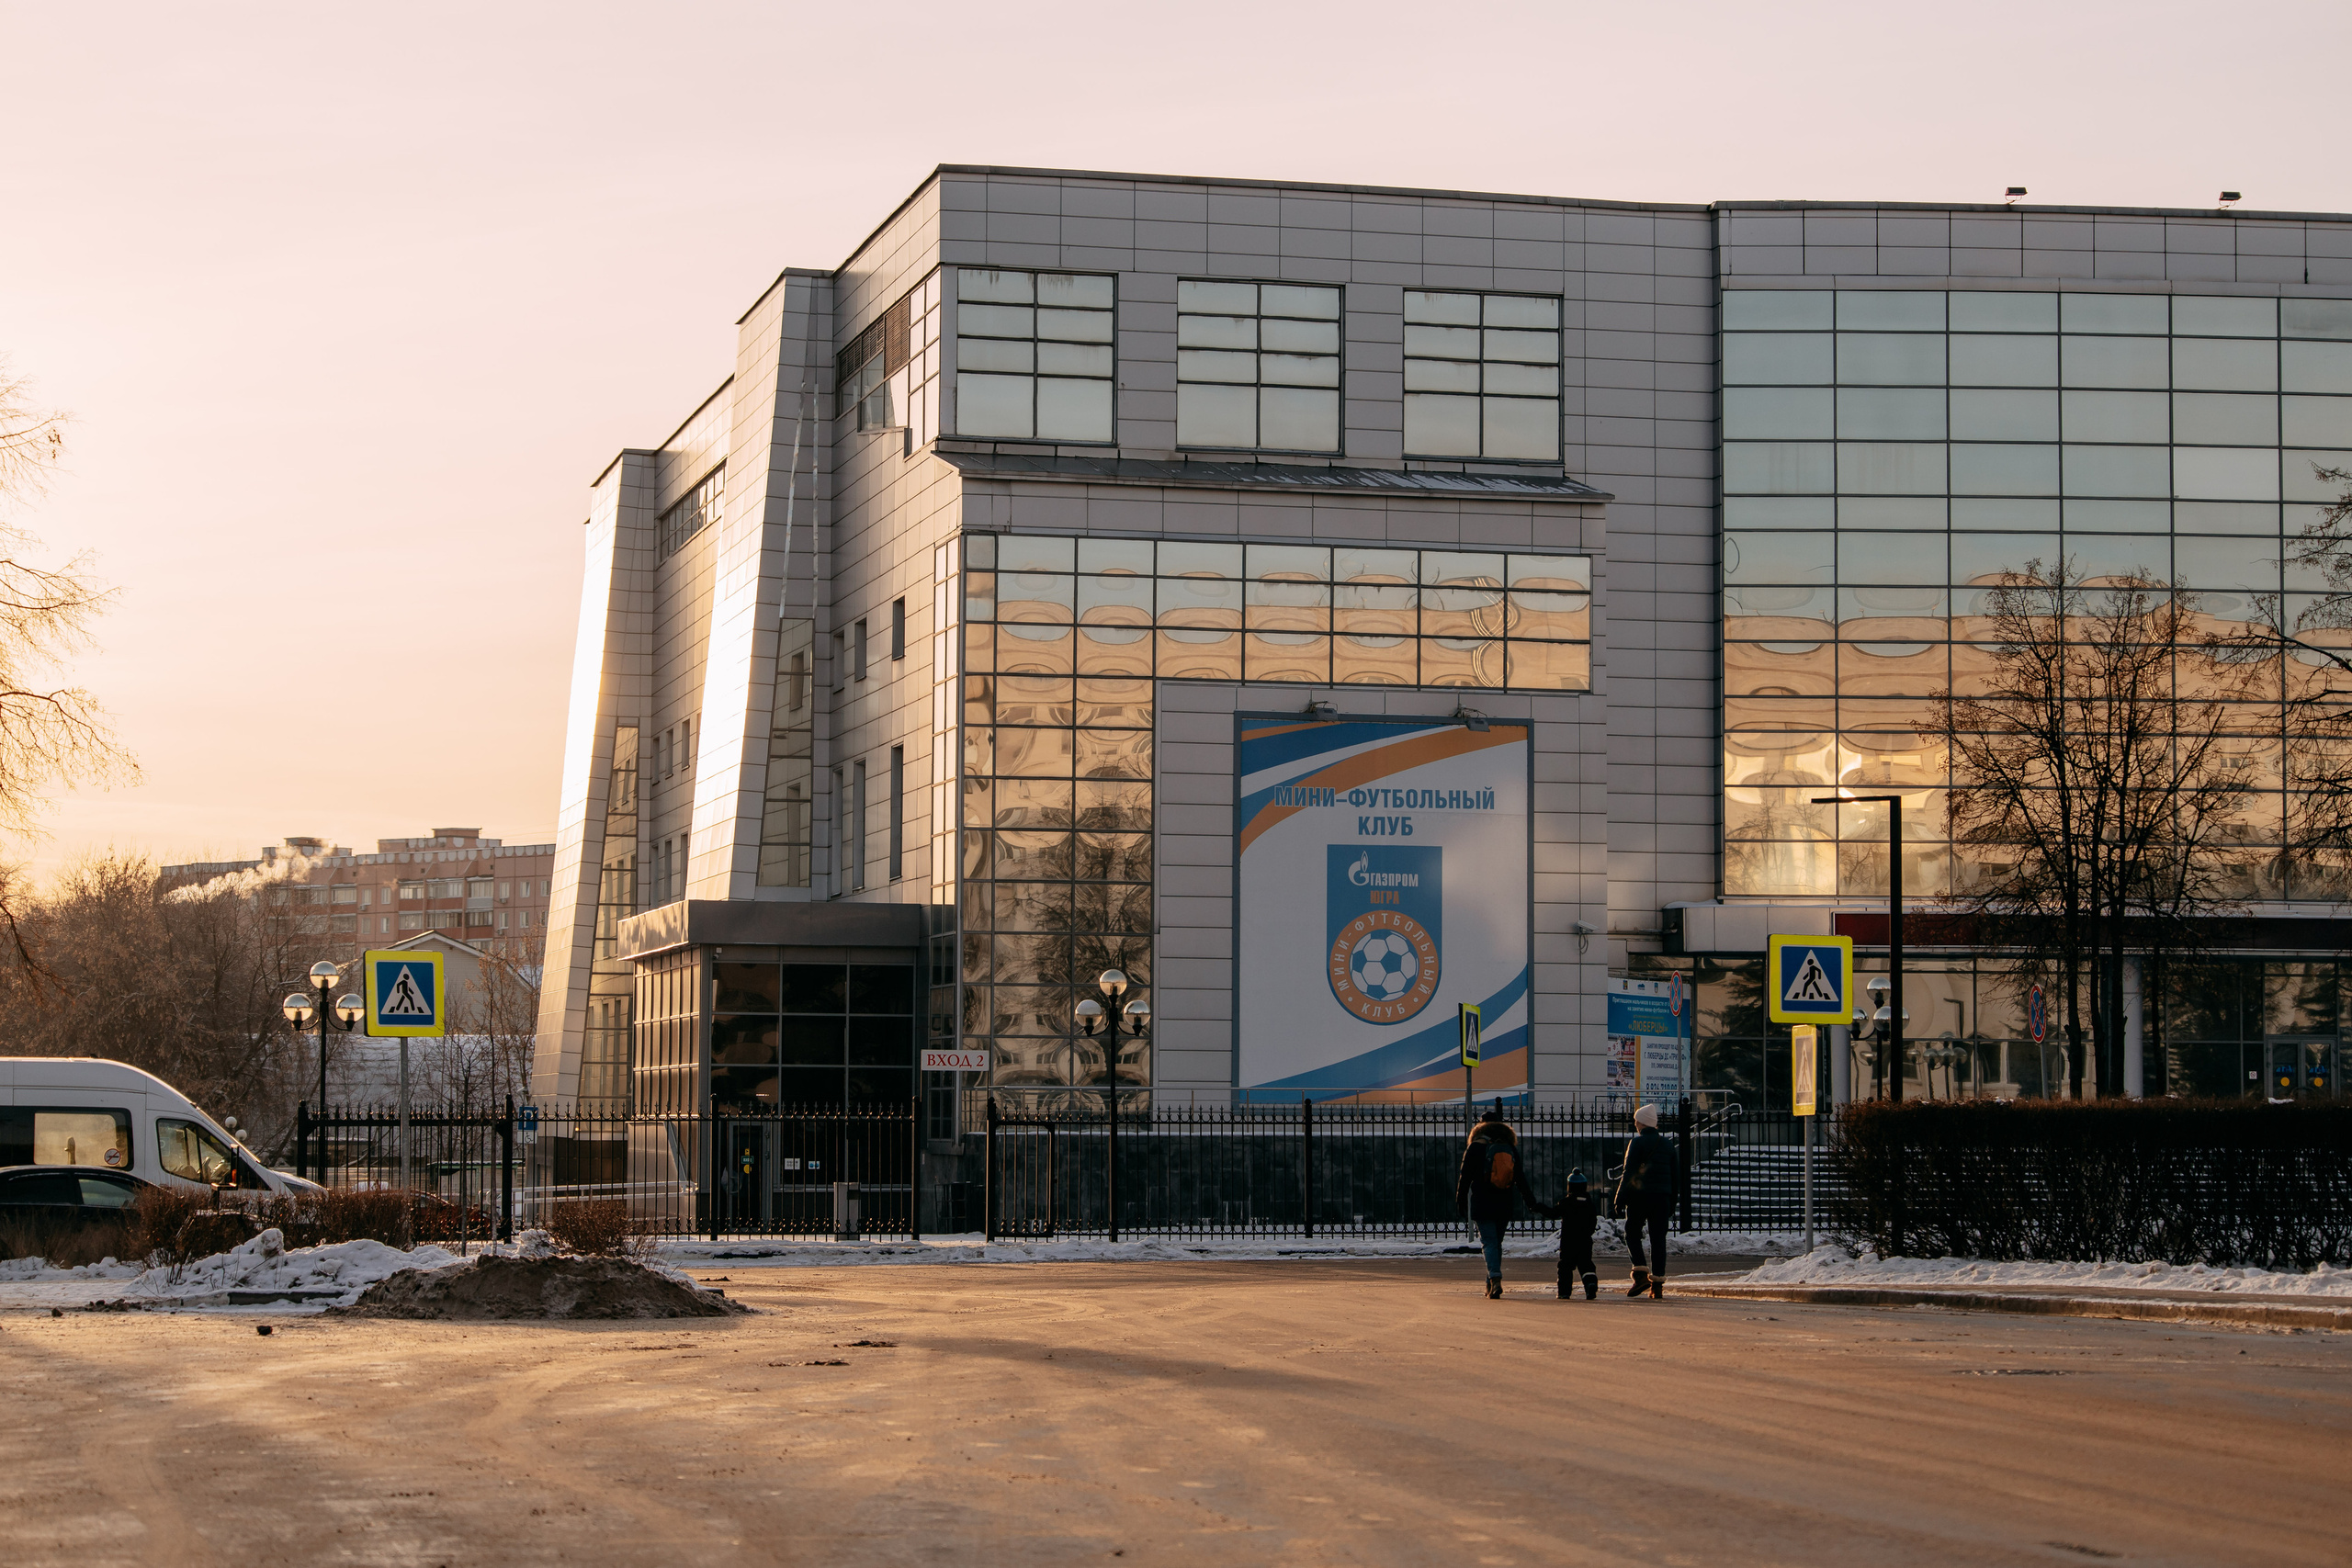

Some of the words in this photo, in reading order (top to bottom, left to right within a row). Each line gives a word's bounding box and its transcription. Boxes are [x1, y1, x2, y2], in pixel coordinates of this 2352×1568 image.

[1274, 786, 1495, 809] МИНИ-ФУТБОЛЬНЫЙ
[1358, 816, 1413, 836] КЛУБ
[1370, 873, 1419, 887] ГАЗПРОМ
[1370, 890, 1399, 905] ЮГРА
[1361, 1002, 1405, 1018] КЛУБ
[1628, 1020, 1668, 1034] «ЛЮБЕРЦЫ»
[927, 1054, 972, 1068] ВХОД
[976, 1055, 984, 1066] 2
